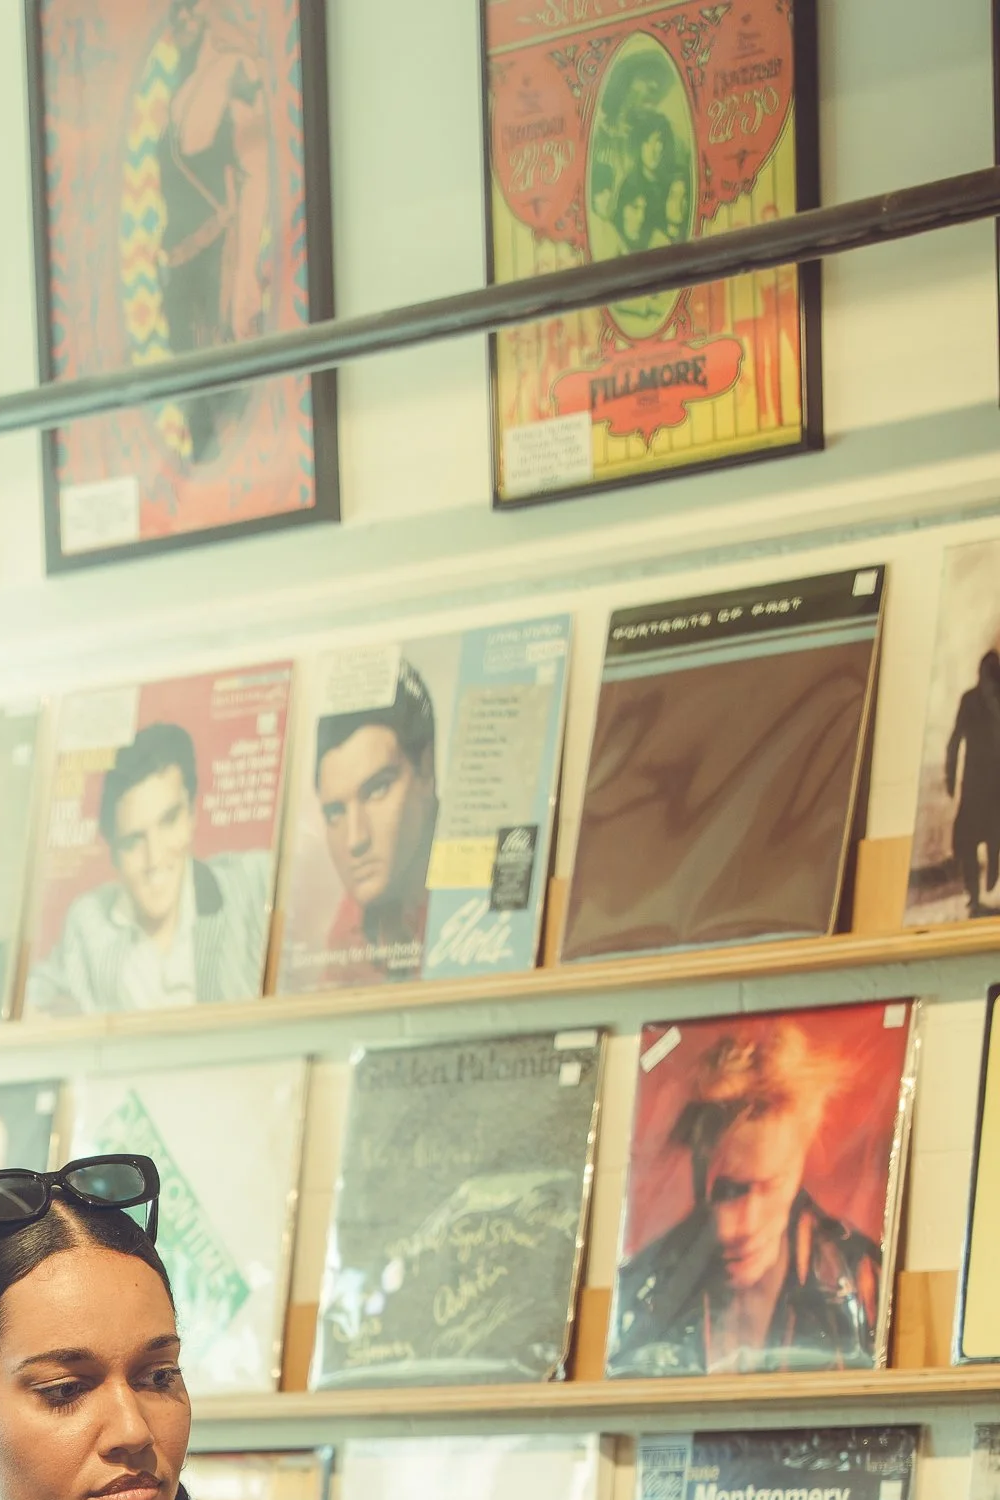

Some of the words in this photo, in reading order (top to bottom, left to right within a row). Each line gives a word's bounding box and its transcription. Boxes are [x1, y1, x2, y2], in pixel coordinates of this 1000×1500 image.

[589, 355, 707, 412] FILLMORE
[613, 611, 712, 640] PORTRAITS
[717, 606, 744, 623] OF
[751, 596, 802, 617] PAST
